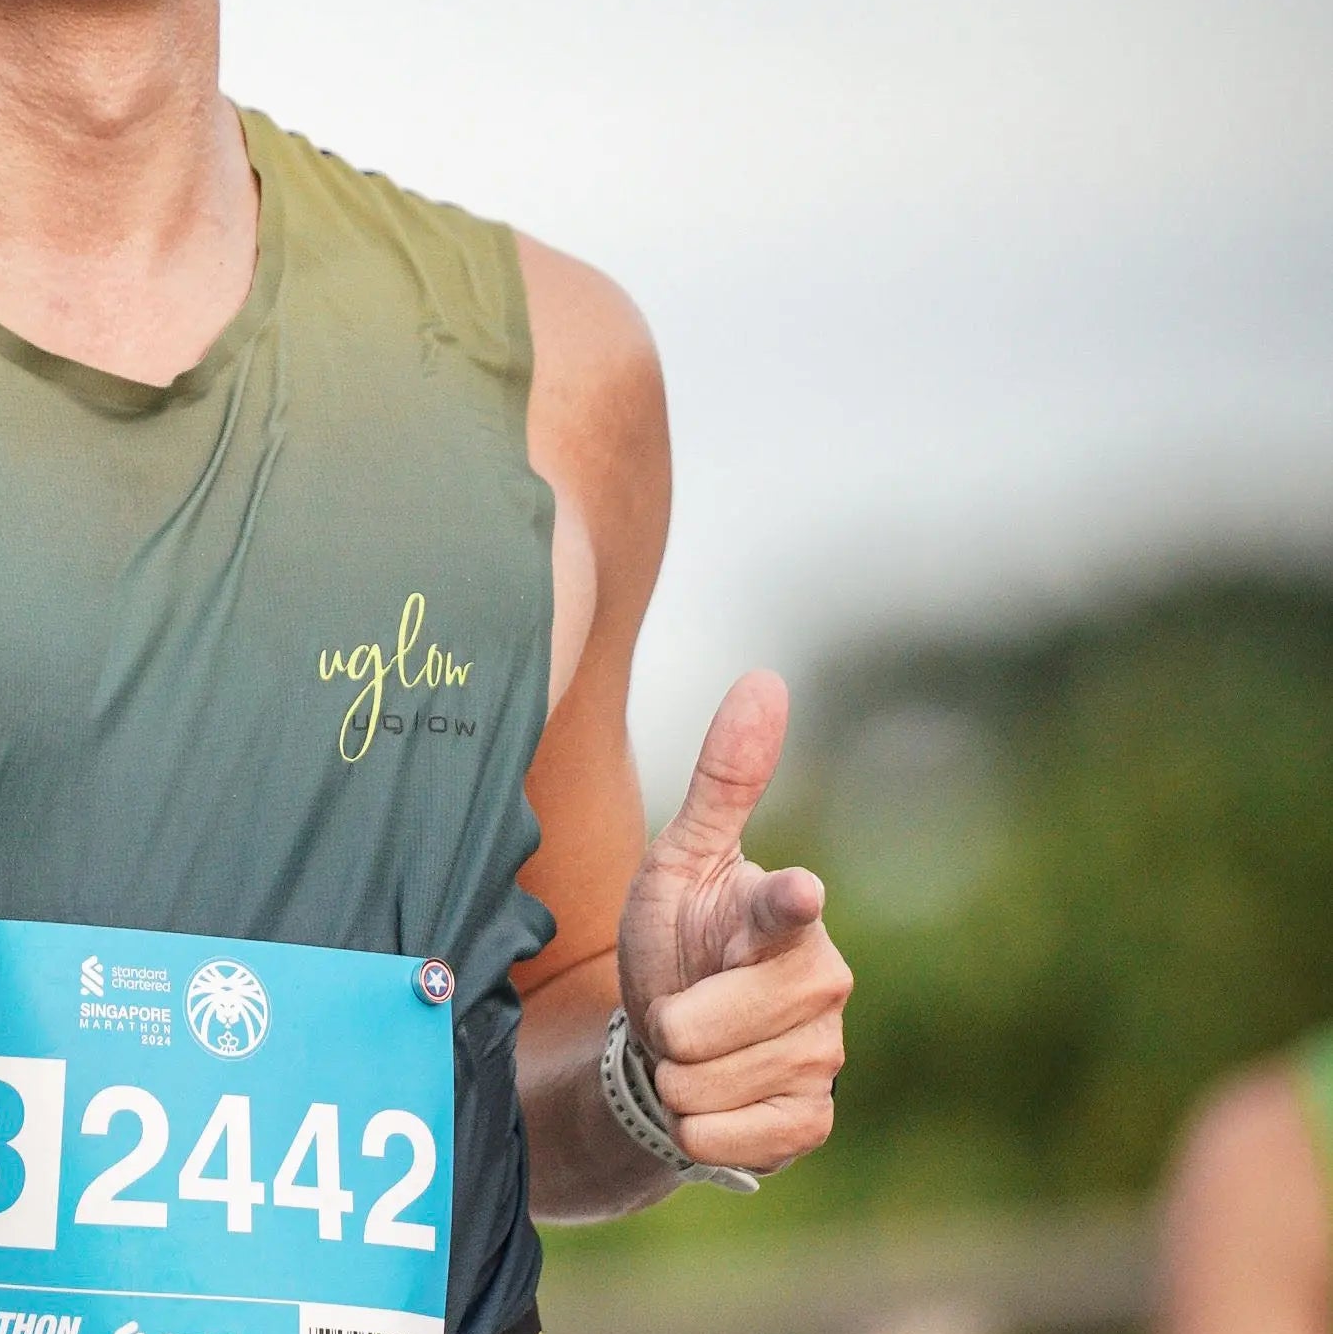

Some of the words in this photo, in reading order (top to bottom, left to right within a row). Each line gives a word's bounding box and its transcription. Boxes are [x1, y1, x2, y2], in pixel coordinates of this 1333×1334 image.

[318, 591, 475, 762] uglow
[110, 965, 168, 981] standard
[110, 978, 171, 993] chartered
[79, 1002, 171, 1023] SINGAPORE
[79, 1018, 171, 1034] MARATHON
[141, 1034, 171, 1047] 2024
[73, 1084, 437, 1252] 2442
